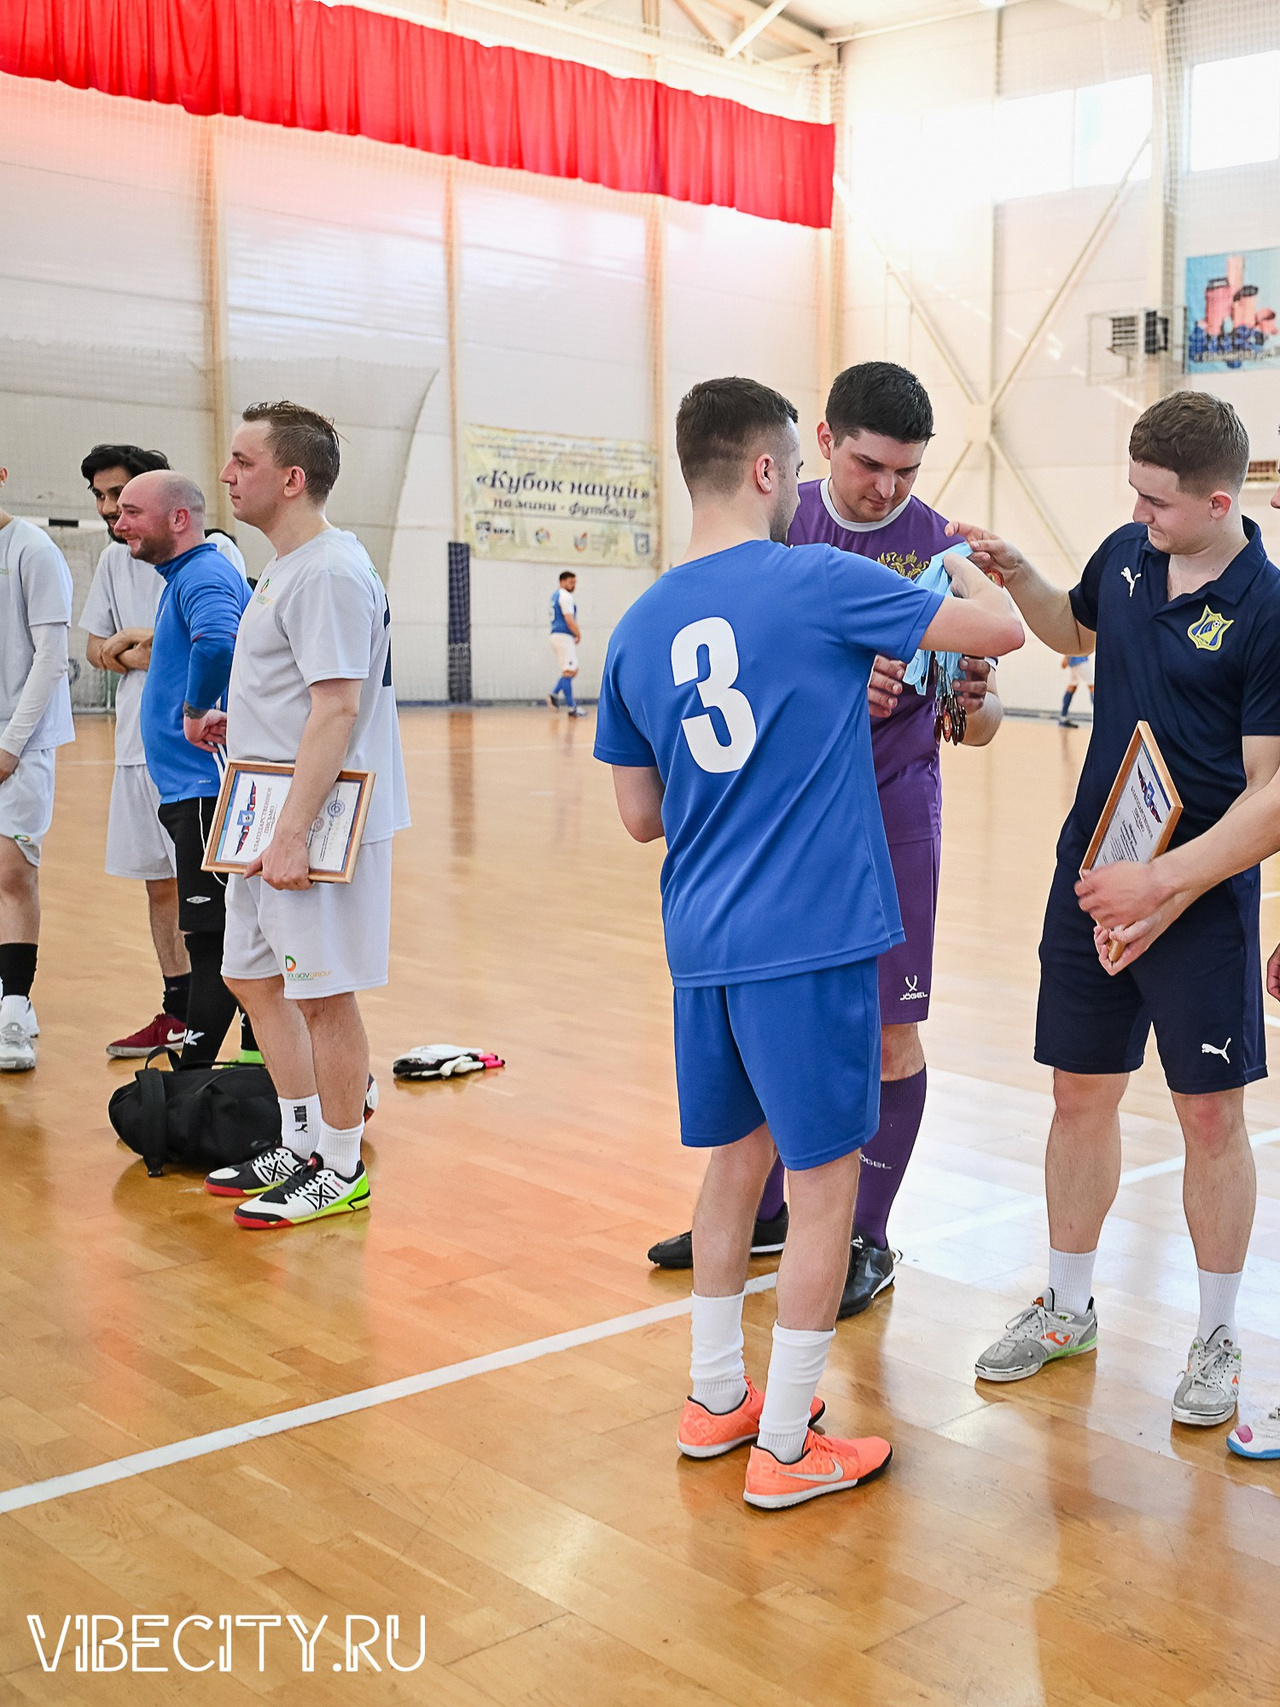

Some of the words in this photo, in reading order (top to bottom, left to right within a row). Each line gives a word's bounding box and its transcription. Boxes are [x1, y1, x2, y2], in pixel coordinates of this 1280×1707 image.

[476, 468, 563, 495] «Кубок
[570, 480, 650, 502] наций»
[493, 498, 513, 509] по
[516, 501, 556, 512] мини
[568, 502, 637, 520] футболу
[671, 616, 757, 774] 3
[900, 991, 929, 1001] JÖGEL
[859, 1153, 893, 1170] ÖGEL
